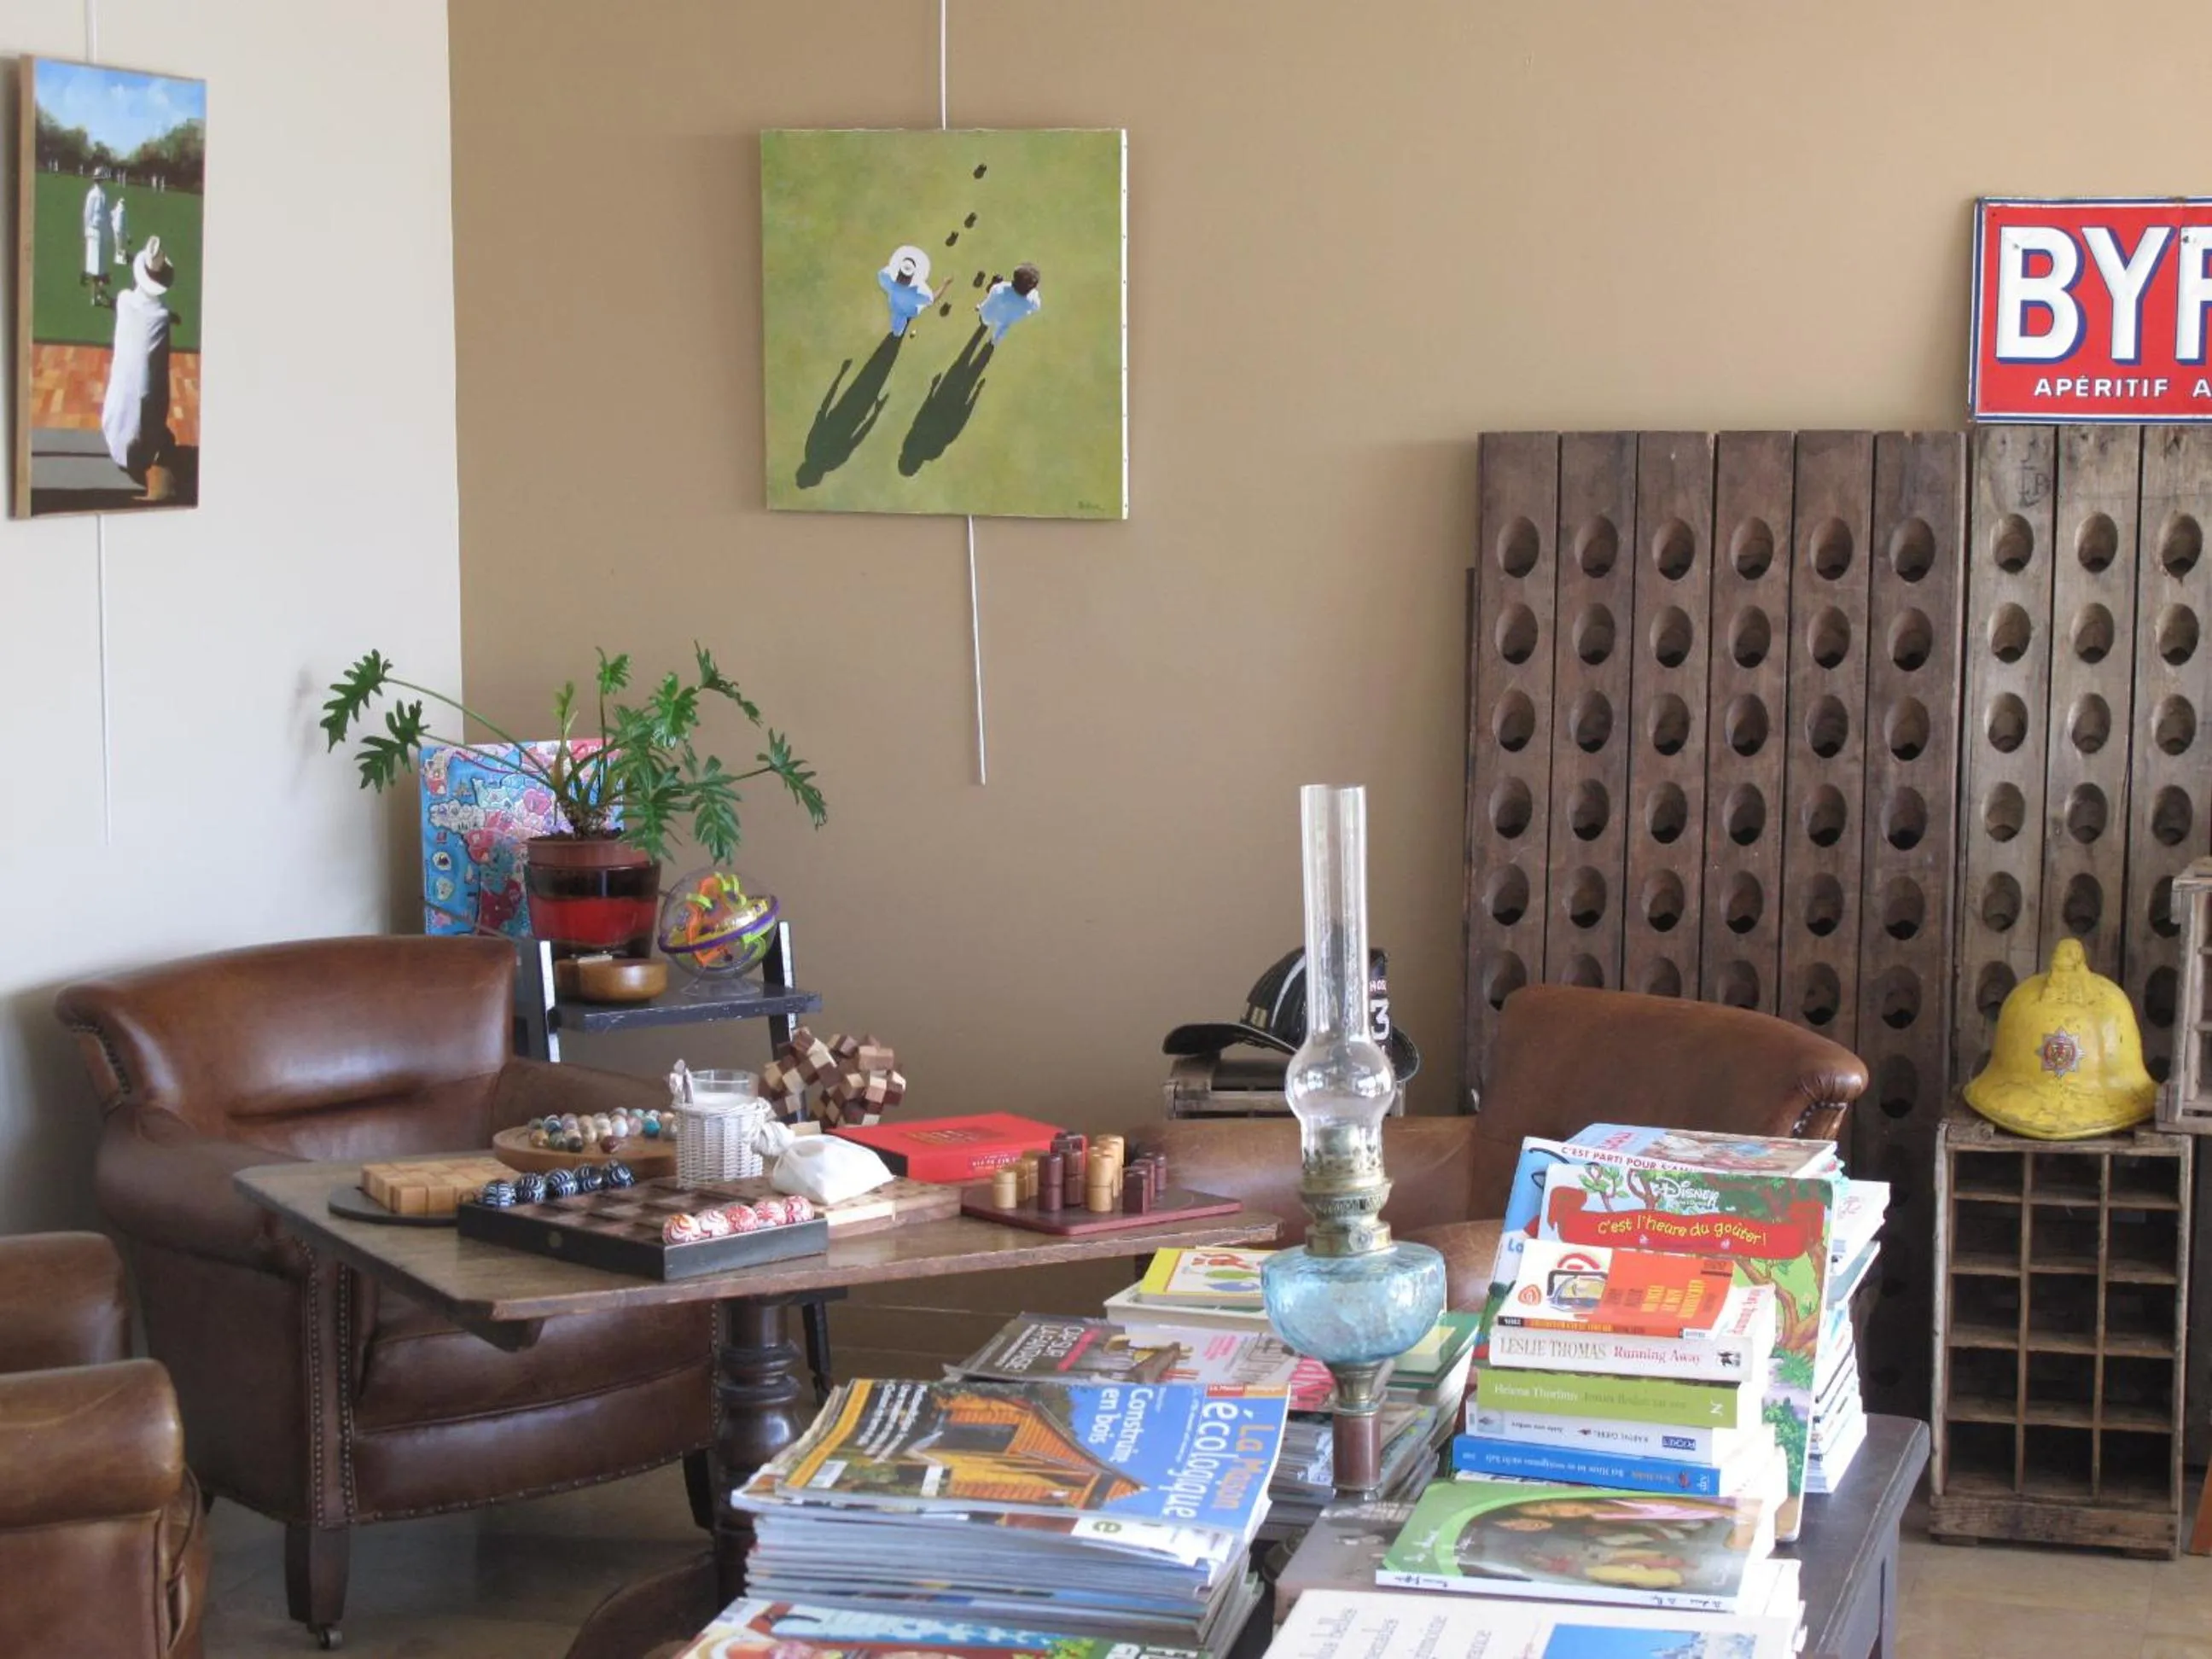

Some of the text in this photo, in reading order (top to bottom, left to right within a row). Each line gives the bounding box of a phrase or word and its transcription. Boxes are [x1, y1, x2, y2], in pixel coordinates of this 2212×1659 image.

[2034, 375, 2168, 398] APÉRITIF
[1369, 998, 1390, 1040] 3
[1593, 1150, 1623, 1164] PARTI
[1598, 1218, 1633, 1235] C'est
[1636, 1214, 1688, 1237] l'heure
[1690, 1221, 1710, 1237] du
[1499, 1337, 1701, 1365] LESLIE THOMAS Running Away
[1087, 1388, 1122, 1445] en bois
[1108, 1388, 1153, 1463] Construire
[1237, 1425, 1275, 1452] La
[1158, 1401, 1254, 1518] écologique
